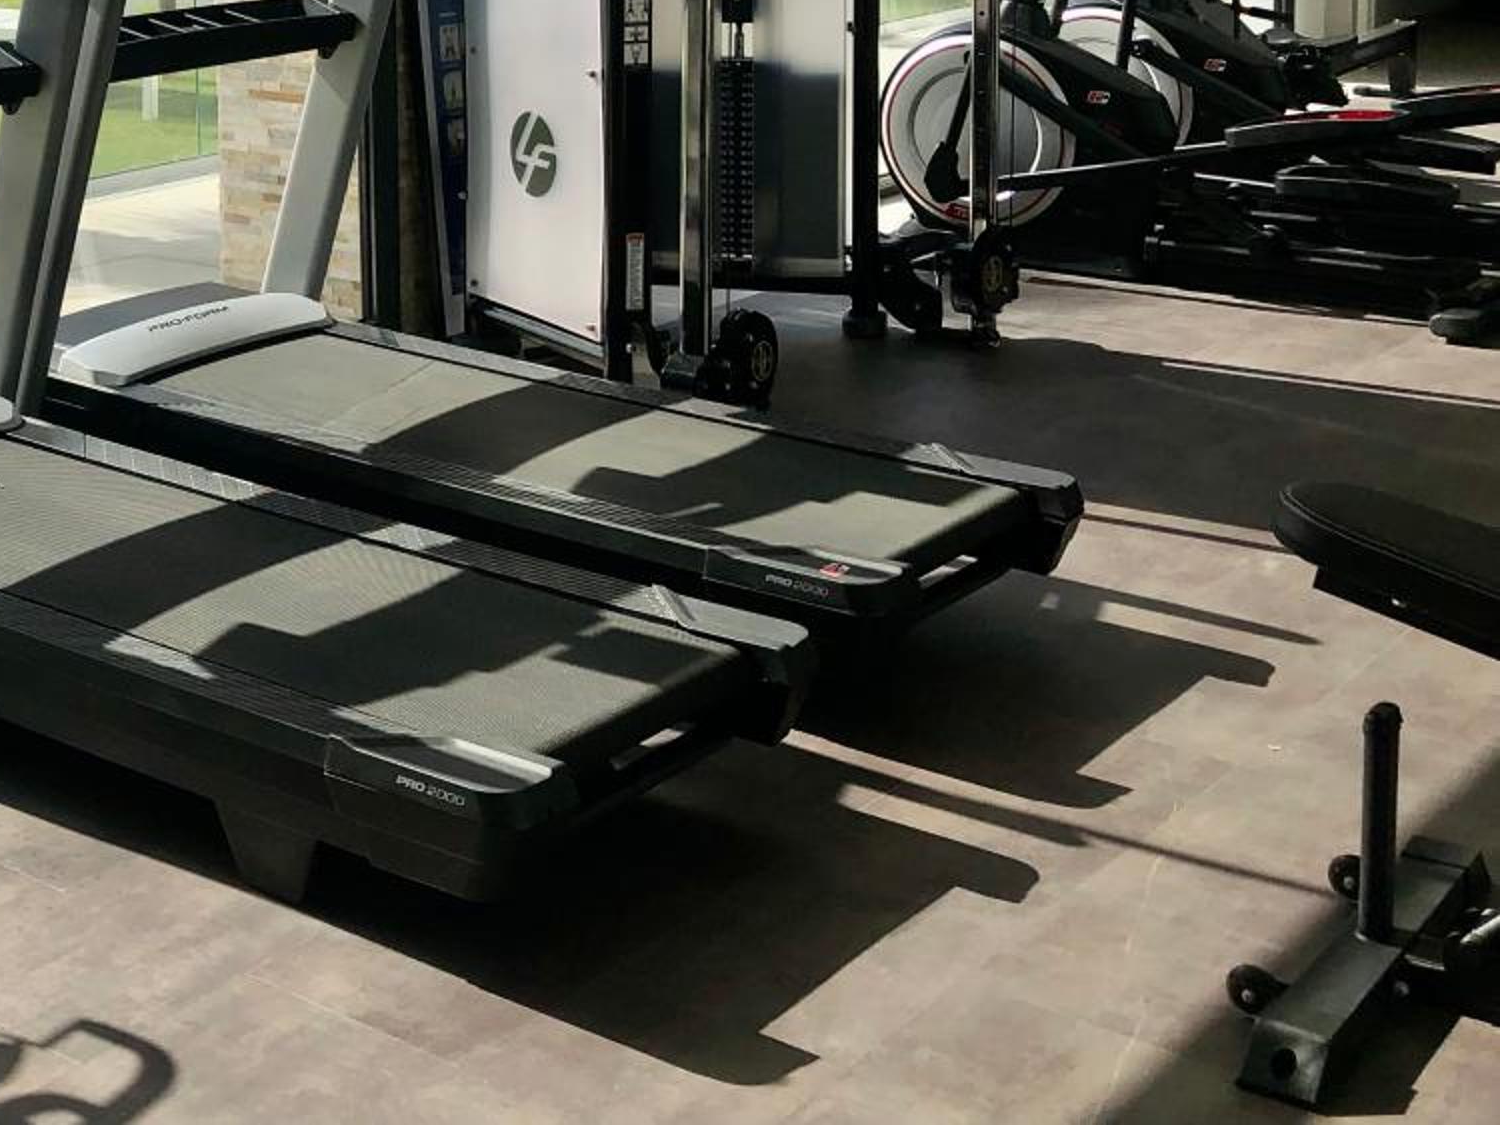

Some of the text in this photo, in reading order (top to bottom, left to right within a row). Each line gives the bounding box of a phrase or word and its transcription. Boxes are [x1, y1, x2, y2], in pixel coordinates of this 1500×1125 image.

[763, 573, 793, 587] PRO
[396, 774, 466, 806] PRO 2000
